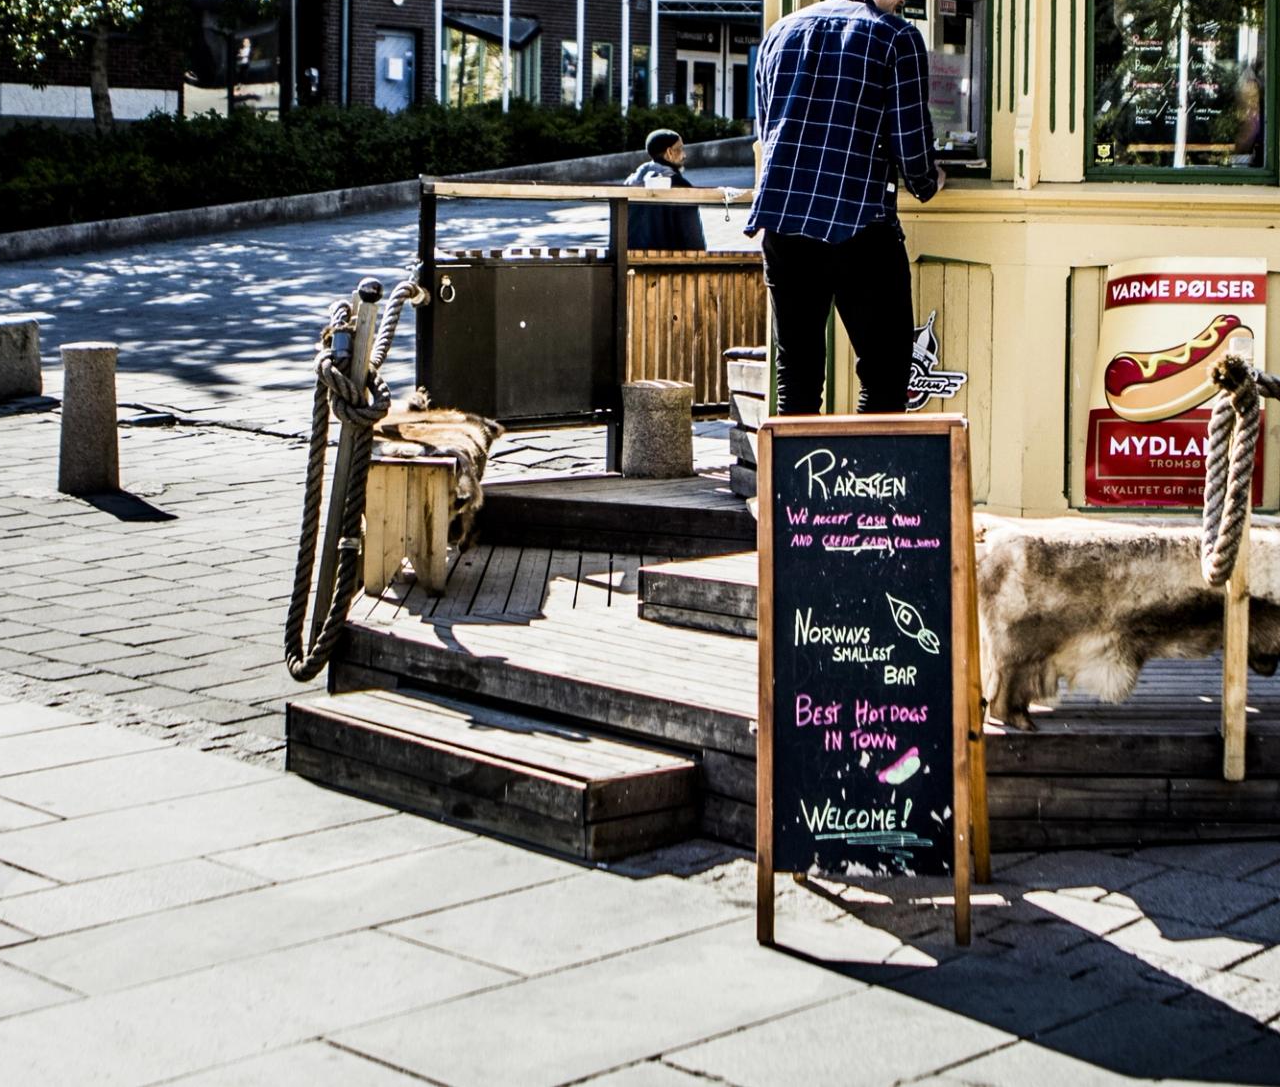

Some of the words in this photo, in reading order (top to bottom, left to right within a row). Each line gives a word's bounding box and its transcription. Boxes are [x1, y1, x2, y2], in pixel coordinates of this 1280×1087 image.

[1112, 279, 1170, 301] VARME
[1175, 280, 1255, 298] PØLSER
[1110, 436, 1211, 456] MYDLA
[1150, 459, 1201, 468] TROMSØ
[1163, 486, 1184, 494] GIR
[857, 514, 887, 527] CASH
[790, 534, 813, 547] AND
[794, 607, 871, 647] NORWAYS
[832, 645, 896, 662] SMALLEST
[883, 665, 918, 686] BAR
[795, 693, 842, 727] BEST
[825, 730, 842, 751] IN
[850, 729, 897, 751] TOWN
